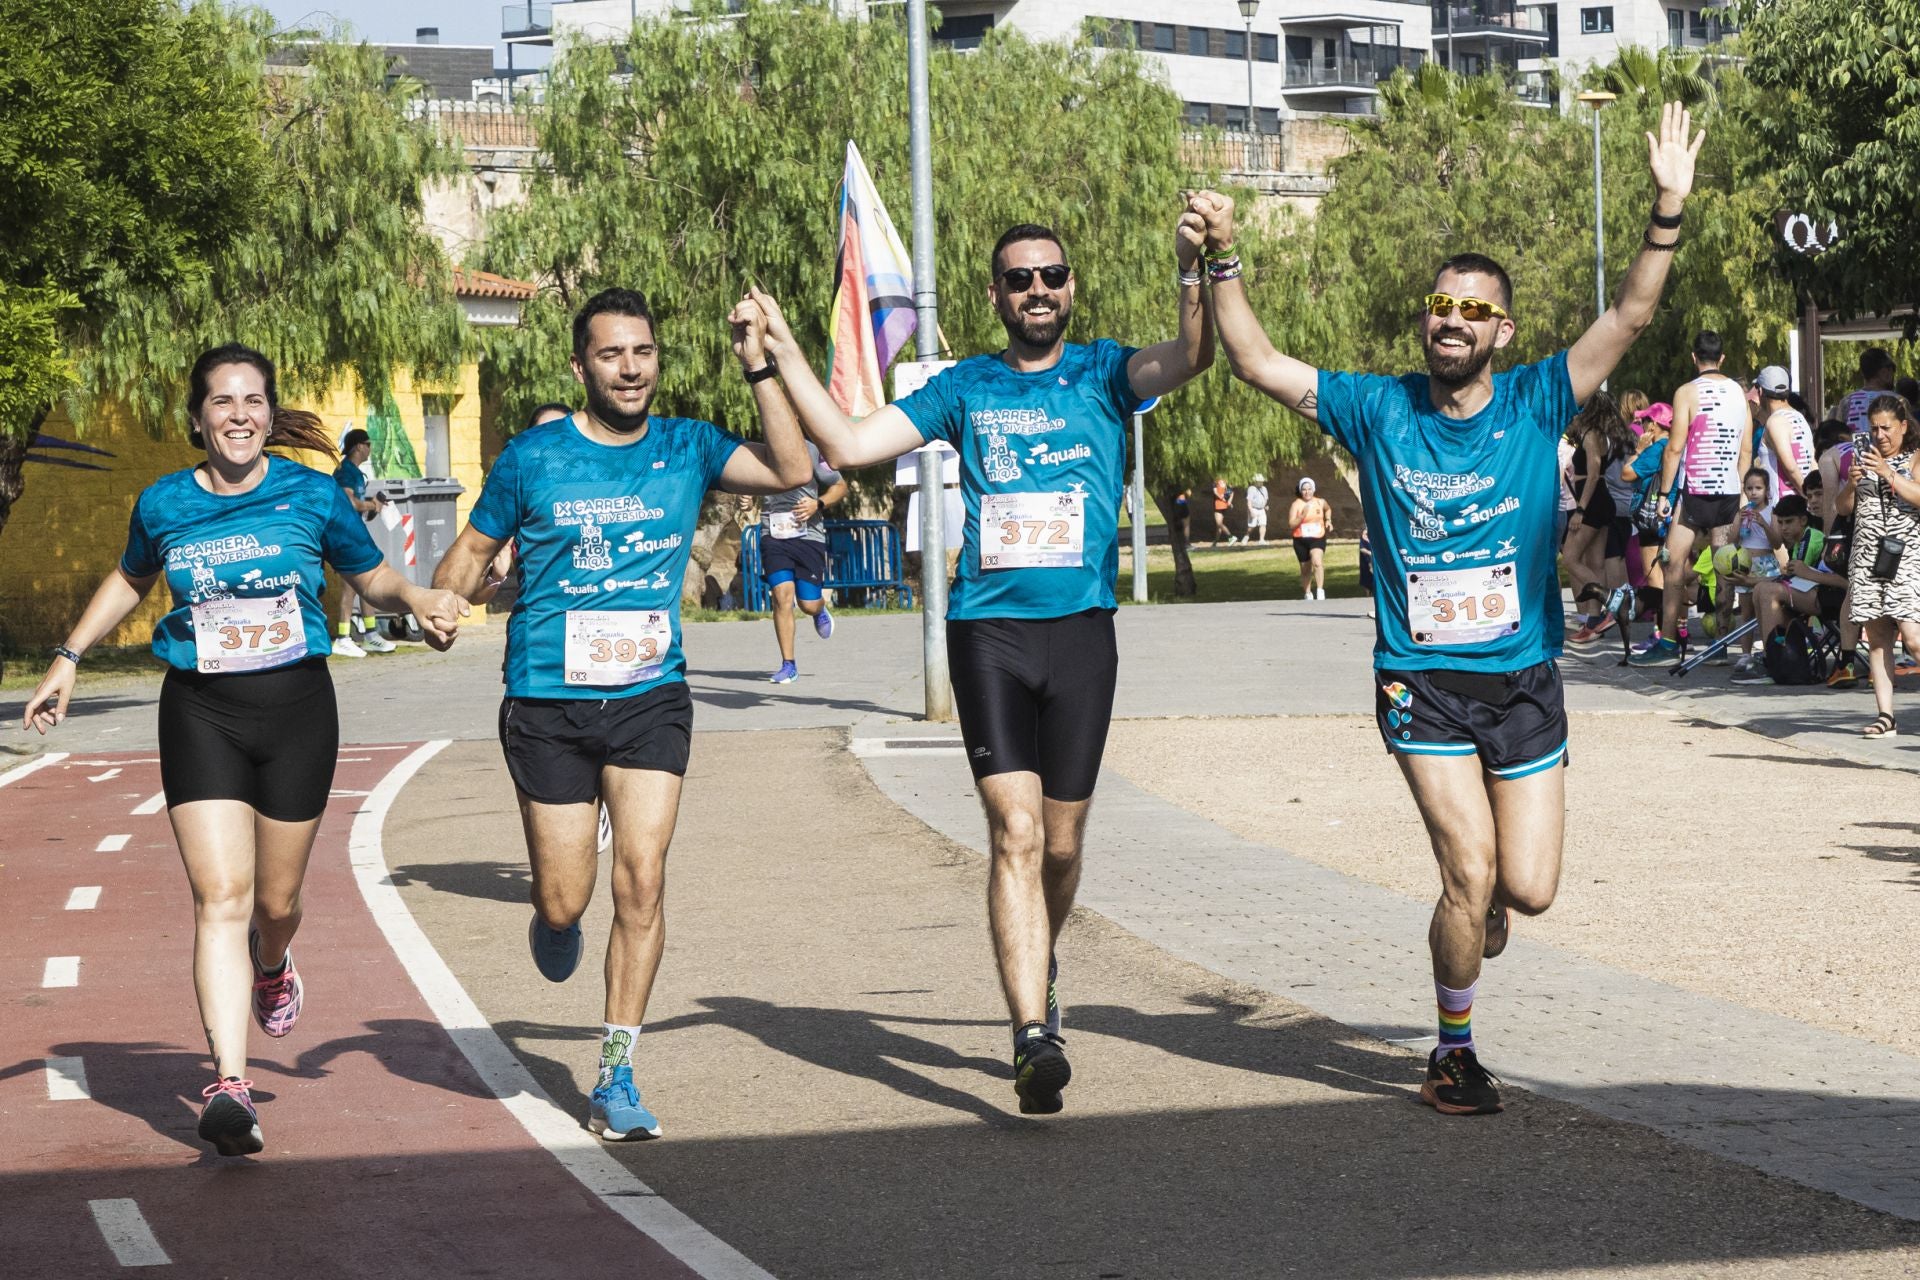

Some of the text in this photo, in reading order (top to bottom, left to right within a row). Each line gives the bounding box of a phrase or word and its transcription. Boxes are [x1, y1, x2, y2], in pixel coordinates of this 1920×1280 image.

[981, 408, 1048, 424] CARRERA
[1002, 418, 1066, 435] DIVERSIDAD
[1040, 443, 1092, 466] aqualia
[986, 468, 1021, 482] m@s
[1411, 470, 1479, 489] CARRERA
[554, 495, 644, 516] IX CARRERA
[1470, 496, 1520, 523] aqualia
[597, 508, 664, 524] DIVERSIDAD
[581, 525, 602, 536] l@s
[1000, 520, 1070, 545] 372
[183, 534, 259, 558] CARRERA
[581, 535, 601, 548] pa
[587, 544, 603, 555] lo
[635, 533, 682, 554] aqualia
[207, 545, 281, 566] DIVERSIDAD
[573, 556, 612, 570] m@s
[255, 570, 301, 591] aqualia
[564, 584, 599, 596] aqualia
[1432, 594, 1505, 622] 319
[219, 621, 291, 649] 373
[589, 637, 658, 662] 393
[203, 660, 220, 669] 5K
[571, 672, 587, 681] 5K
